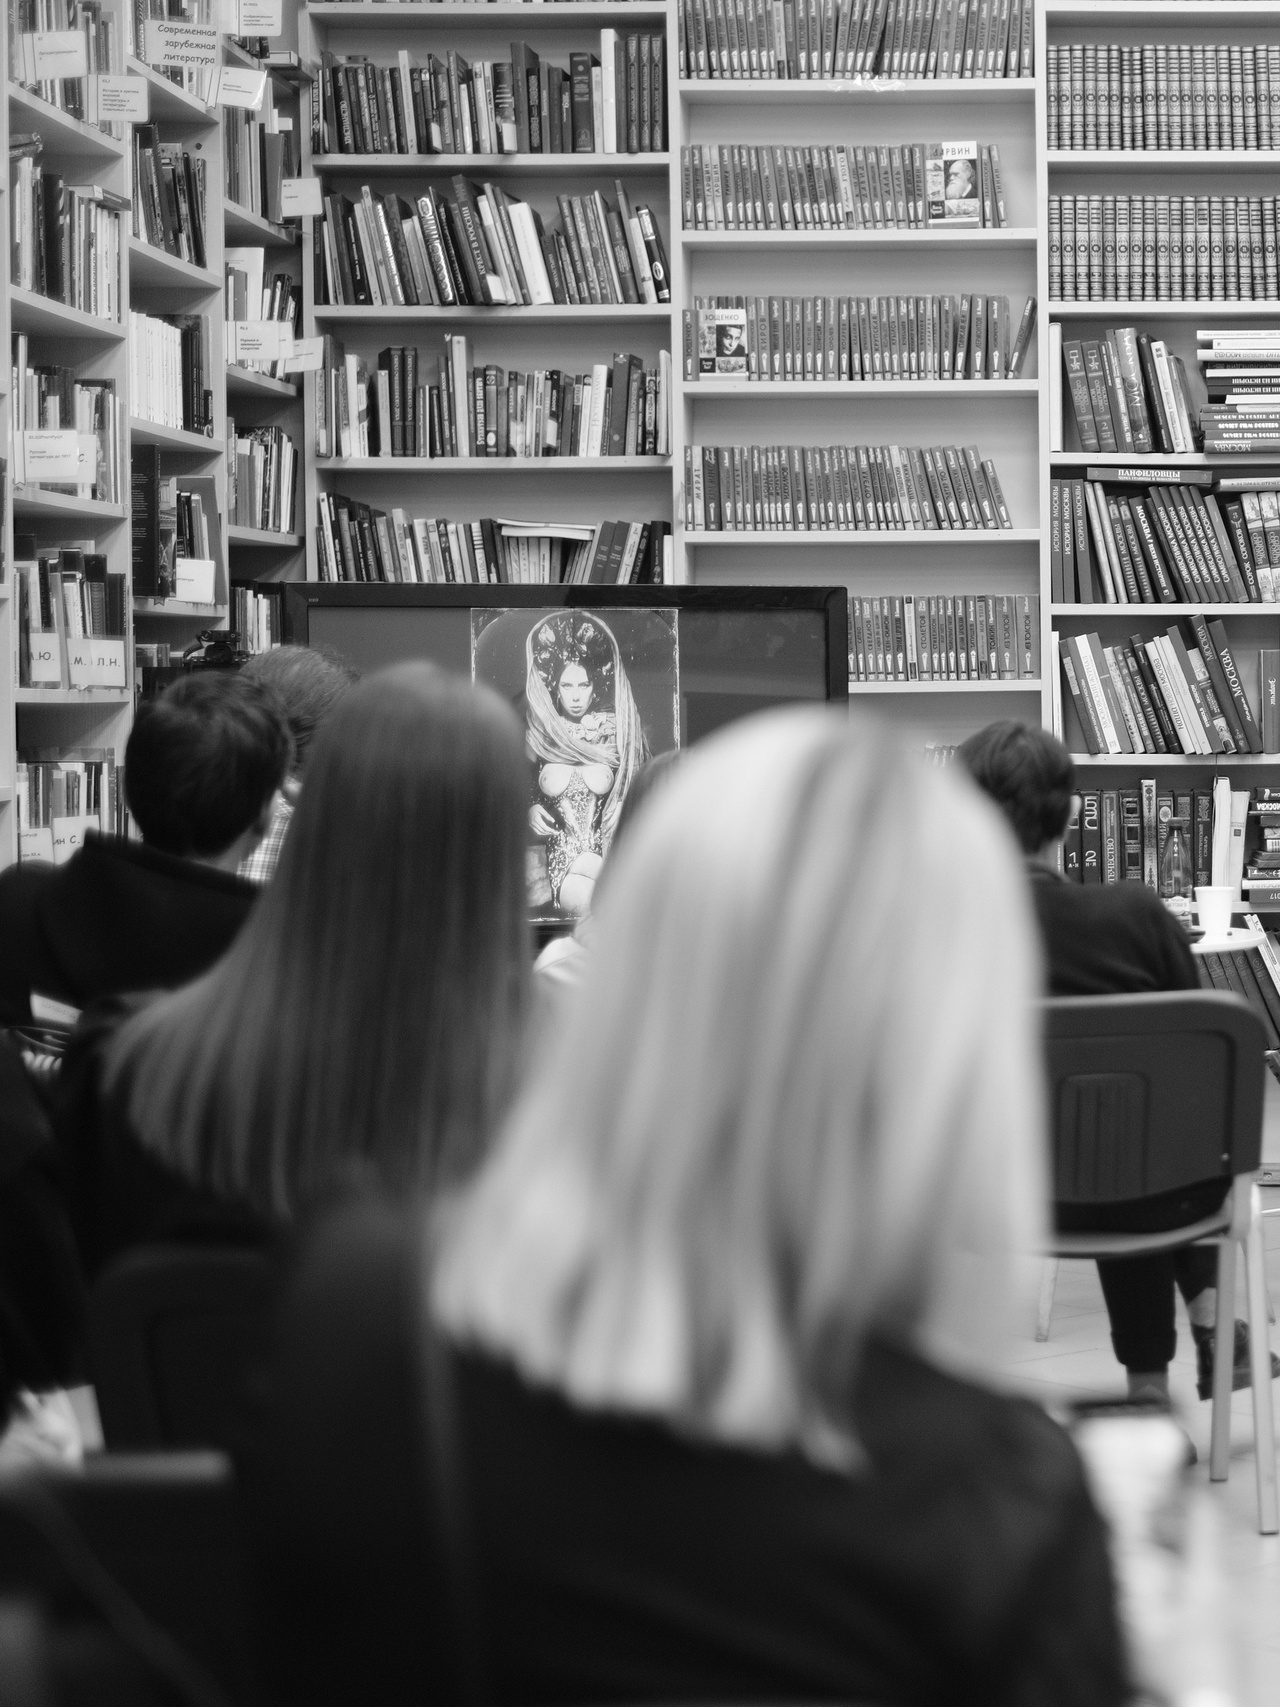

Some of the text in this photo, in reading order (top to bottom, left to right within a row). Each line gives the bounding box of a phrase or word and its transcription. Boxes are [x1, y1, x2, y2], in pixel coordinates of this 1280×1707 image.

[157, 24, 217, 37] Современная
[978, 21, 986, 50] ВОЛЬТЕР
[163, 54, 215, 65] литература
[164, 40, 216, 51] зарубежная
[704, 163, 712, 197] ГАРШИН
[839, 157, 847, 182] ГЮГО
[859, 165, 867, 198] ДАВИД
[883, 170, 891, 196] ДАЛЬ
[895, 171, 903, 196] ДАЛЬ
[462, 205, 486, 274] КРЕСТ РОССИИ
[759, 318, 767, 350] КИРОВ
[1214, 443, 1251, 452] МОСКВА
[782, 467, 790, 499] НАХИМОВ
[862, 471, 871, 499] ОРУЭЛЛ
[1118, 469, 1180, 478] ПАНФИЛОВЦЫ
[1075, 485, 1083, 516] МОСКВЫ
[1115, 523, 1127, 554] МОСКВЫ
[1136, 505, 1166, 587] МОСКВА ИСТОРИИ
[1158, 506, 1191, 584] СИМВОЛИКА МОСКВЫ
[1178, 506, 1210, 583] СИМВОЛИКА МОСКВЫ
[1198, 506, 1230, 582] СИМВОЛИКА МОСКВЫ
[1235, 529, 1254, 584] СОРОК СОРОКОВ
[1002, 614, 1010, 640] ТОЛСТОЙ
[1022, 615, 1031, 639] ТОЛСТОЙ
[1197, 625, 1214, 660] МОСКВА
[97, 657, 121, 668] Л.Н.
[1220, 648, 1243, 697] МОСКВА
[1069, 852, 1076, 863] 1
[1085, 850, 1096, 862] 2
